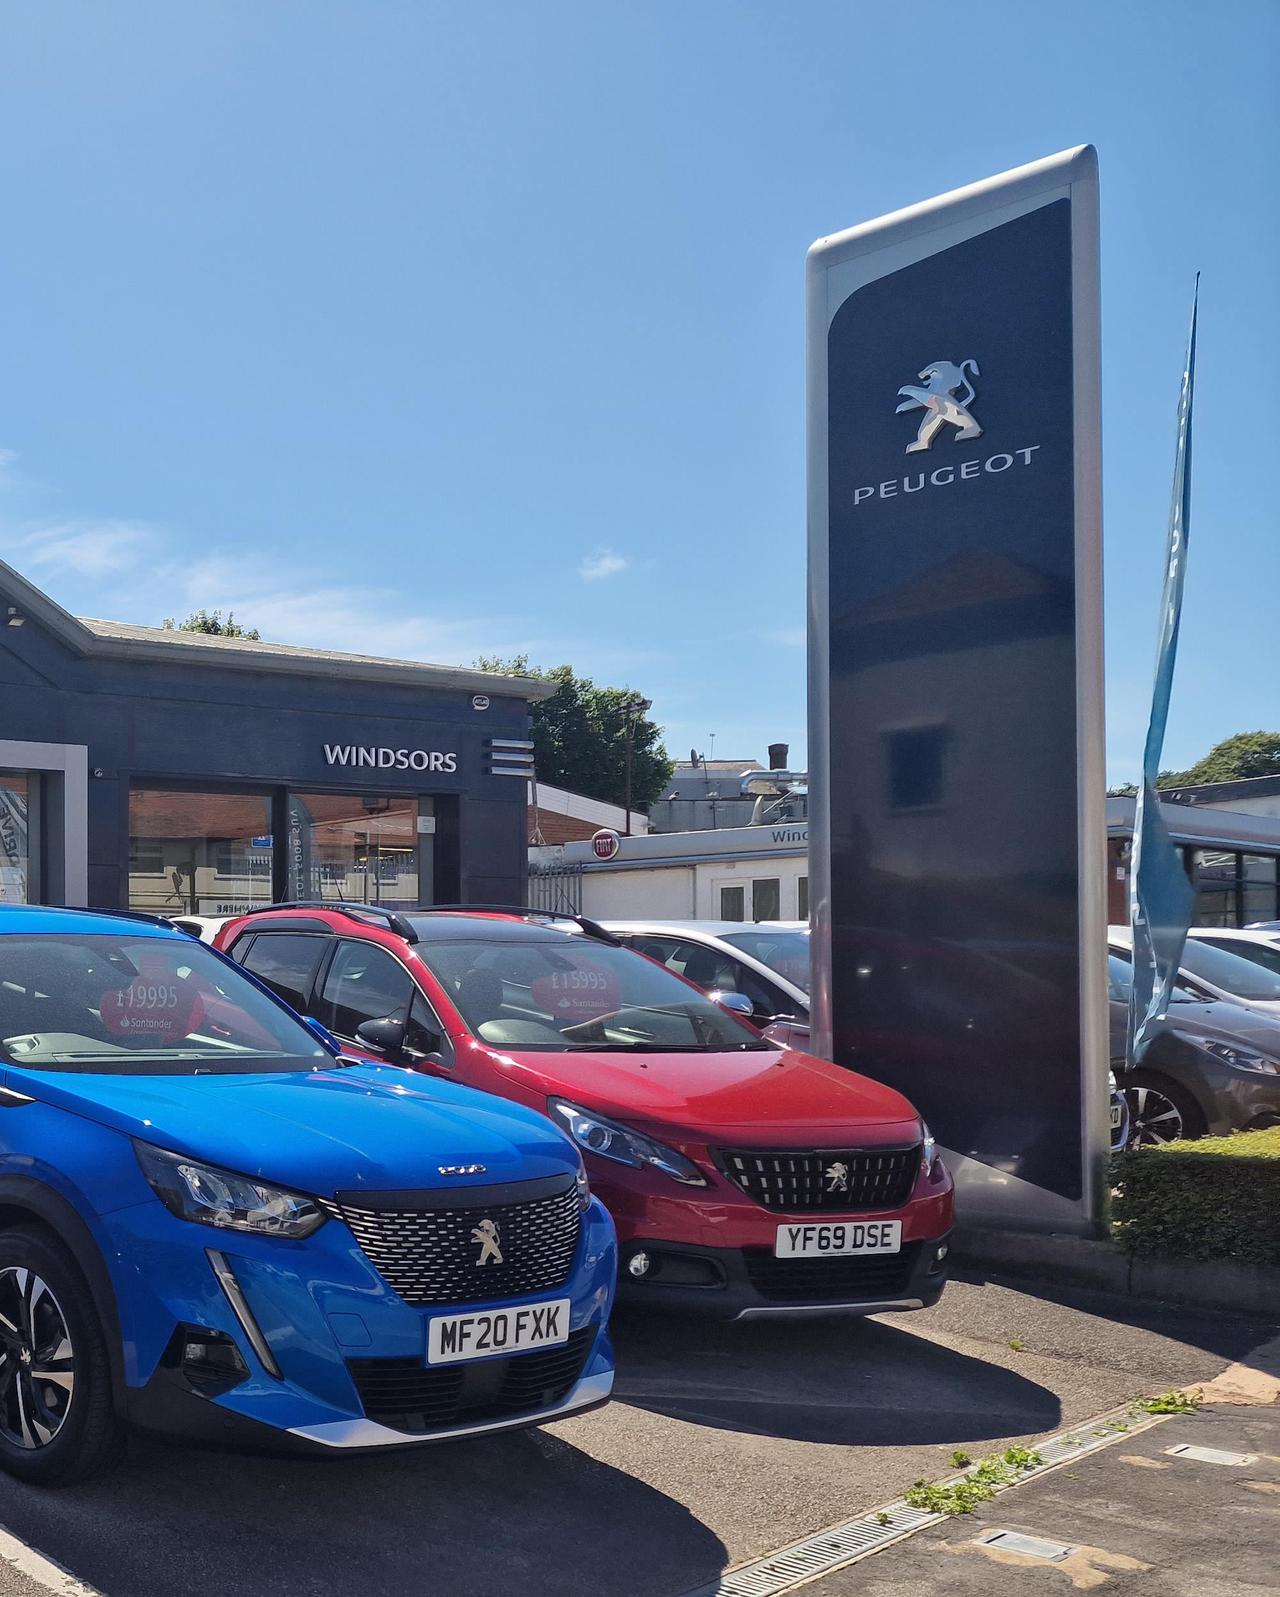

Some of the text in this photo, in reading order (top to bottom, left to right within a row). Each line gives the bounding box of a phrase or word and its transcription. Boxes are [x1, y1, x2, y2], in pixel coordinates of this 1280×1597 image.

[853, 445, 1041, 505] PEUGEOT
[323, 744, 458, 773] WINDSORS
[596, 838, 612, 853] FIAT
[116, 984, 178, 1009] £19995
[130, 1017, 174, 1030] Santander
[787, 1223, 894, 1252] YF69 DSE
[440, 1305, 561, 1355] MF20 FXK
